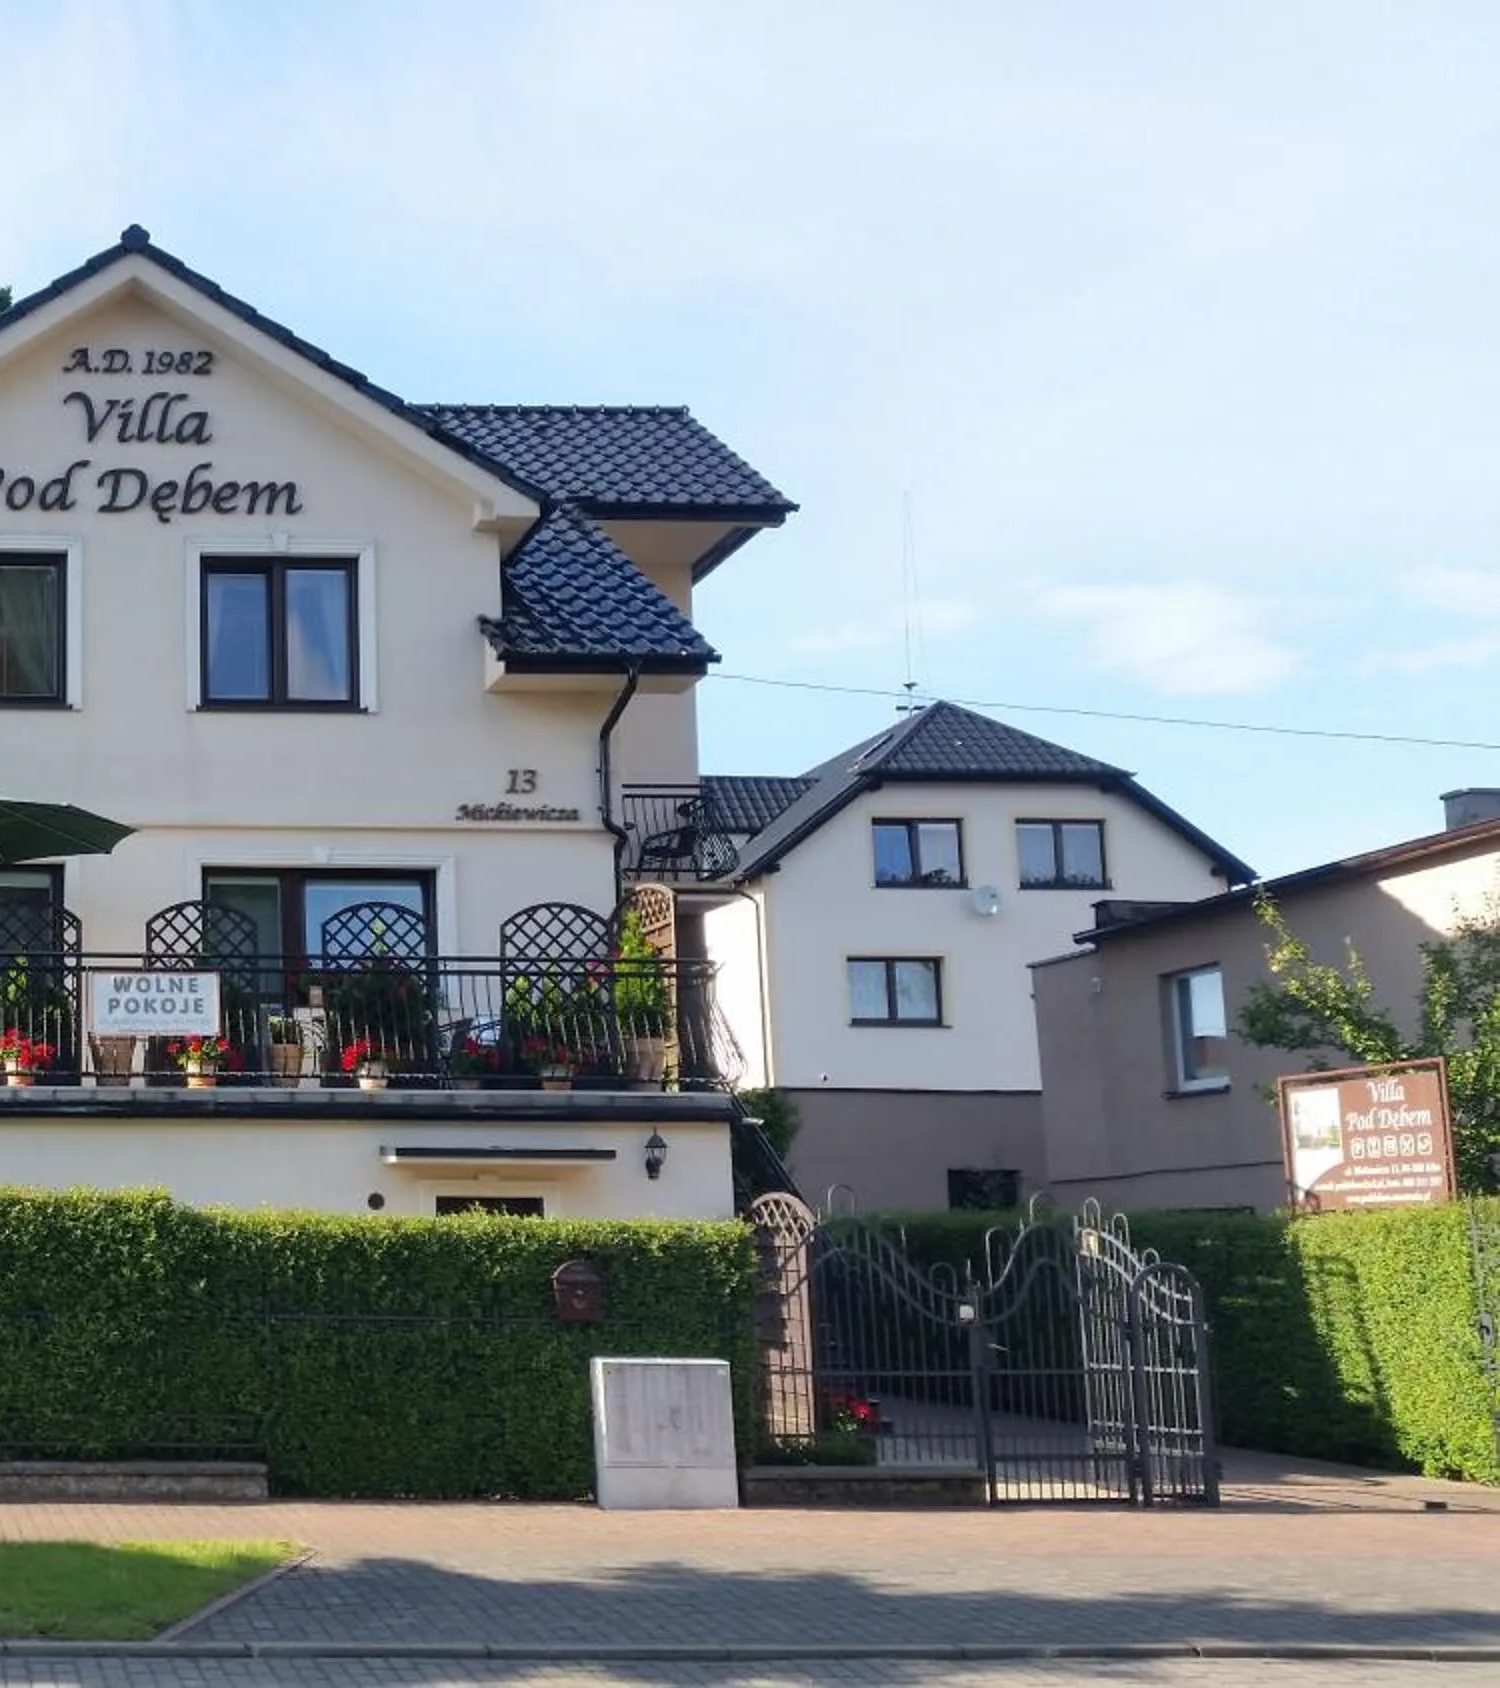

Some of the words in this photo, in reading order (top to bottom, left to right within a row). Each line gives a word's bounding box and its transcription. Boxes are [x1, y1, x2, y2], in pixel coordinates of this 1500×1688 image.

[62, 347, 133, 374] A.D.
[141, 350, 214, 376] 1982
[63, 391, 214, 445] Villa
[96, 462, 303, 523] Dębem
[505, 768, 538, 795] 13
[455, 802, 581, 821] Mickiewicza
[113, 976, 200, 993] WOLNE
[108, 997, 205, 1014] POKOJE
[1366, 1077, 1406, 1103] Villa
[1345, 1107, 1376, 1131] Pod
[1378, 1104, 1432, 1130] Dębem
